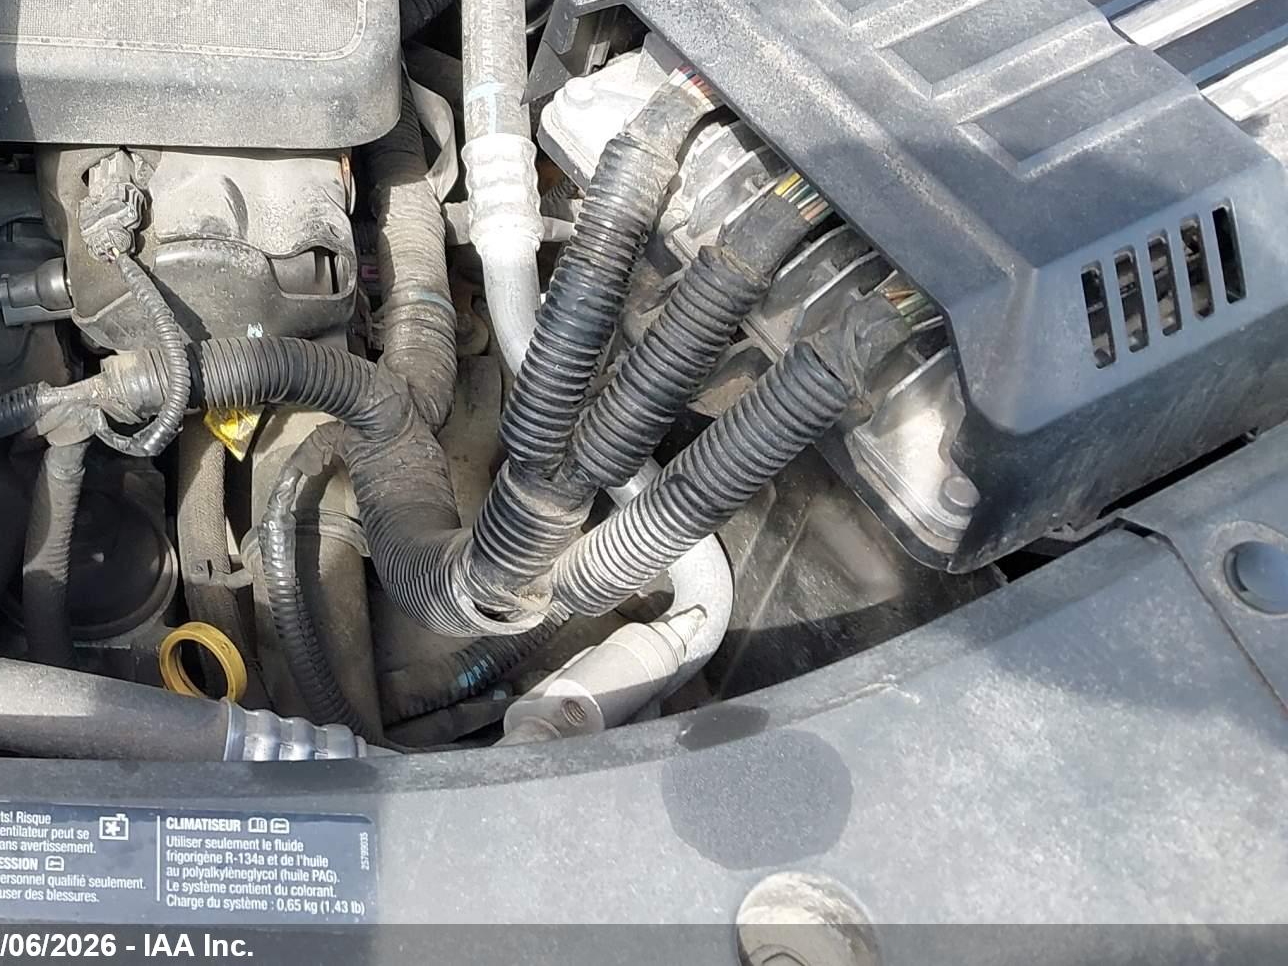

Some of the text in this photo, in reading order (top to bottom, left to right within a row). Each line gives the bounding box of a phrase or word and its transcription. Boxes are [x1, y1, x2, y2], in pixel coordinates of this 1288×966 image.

[16, 812, 51, 825] Risque
[166, 816, 241, 832] CLIMATISEUR
[51, 828, 74, 840] peut
[77, 829, 89, 839] se
[20, 841, 96, 854] avertissement.
[166, 835, 304, 852] Utiliser seulement le fluide
[166, 850, 329, 868] frigorigène R-134a et de l'huile
[47, 874, 86, 888] qualifié
[89, 876, 146, 890] seulement.
[166, 865, 340, 883] au polyalkylèneglycol (huile PAG).
[25, 888, 43, 900] des
[47, 889, 100, 903] blessures.
[166, 880, 336, 898] Le système contient du colorant.
[166, 894, 204, 909] Charge
[206, 896, 221, 908] du
[223, 898, 267, 912] système
[304, 901, 317, 914] kg
[351, 902, 365, 915] lb)
